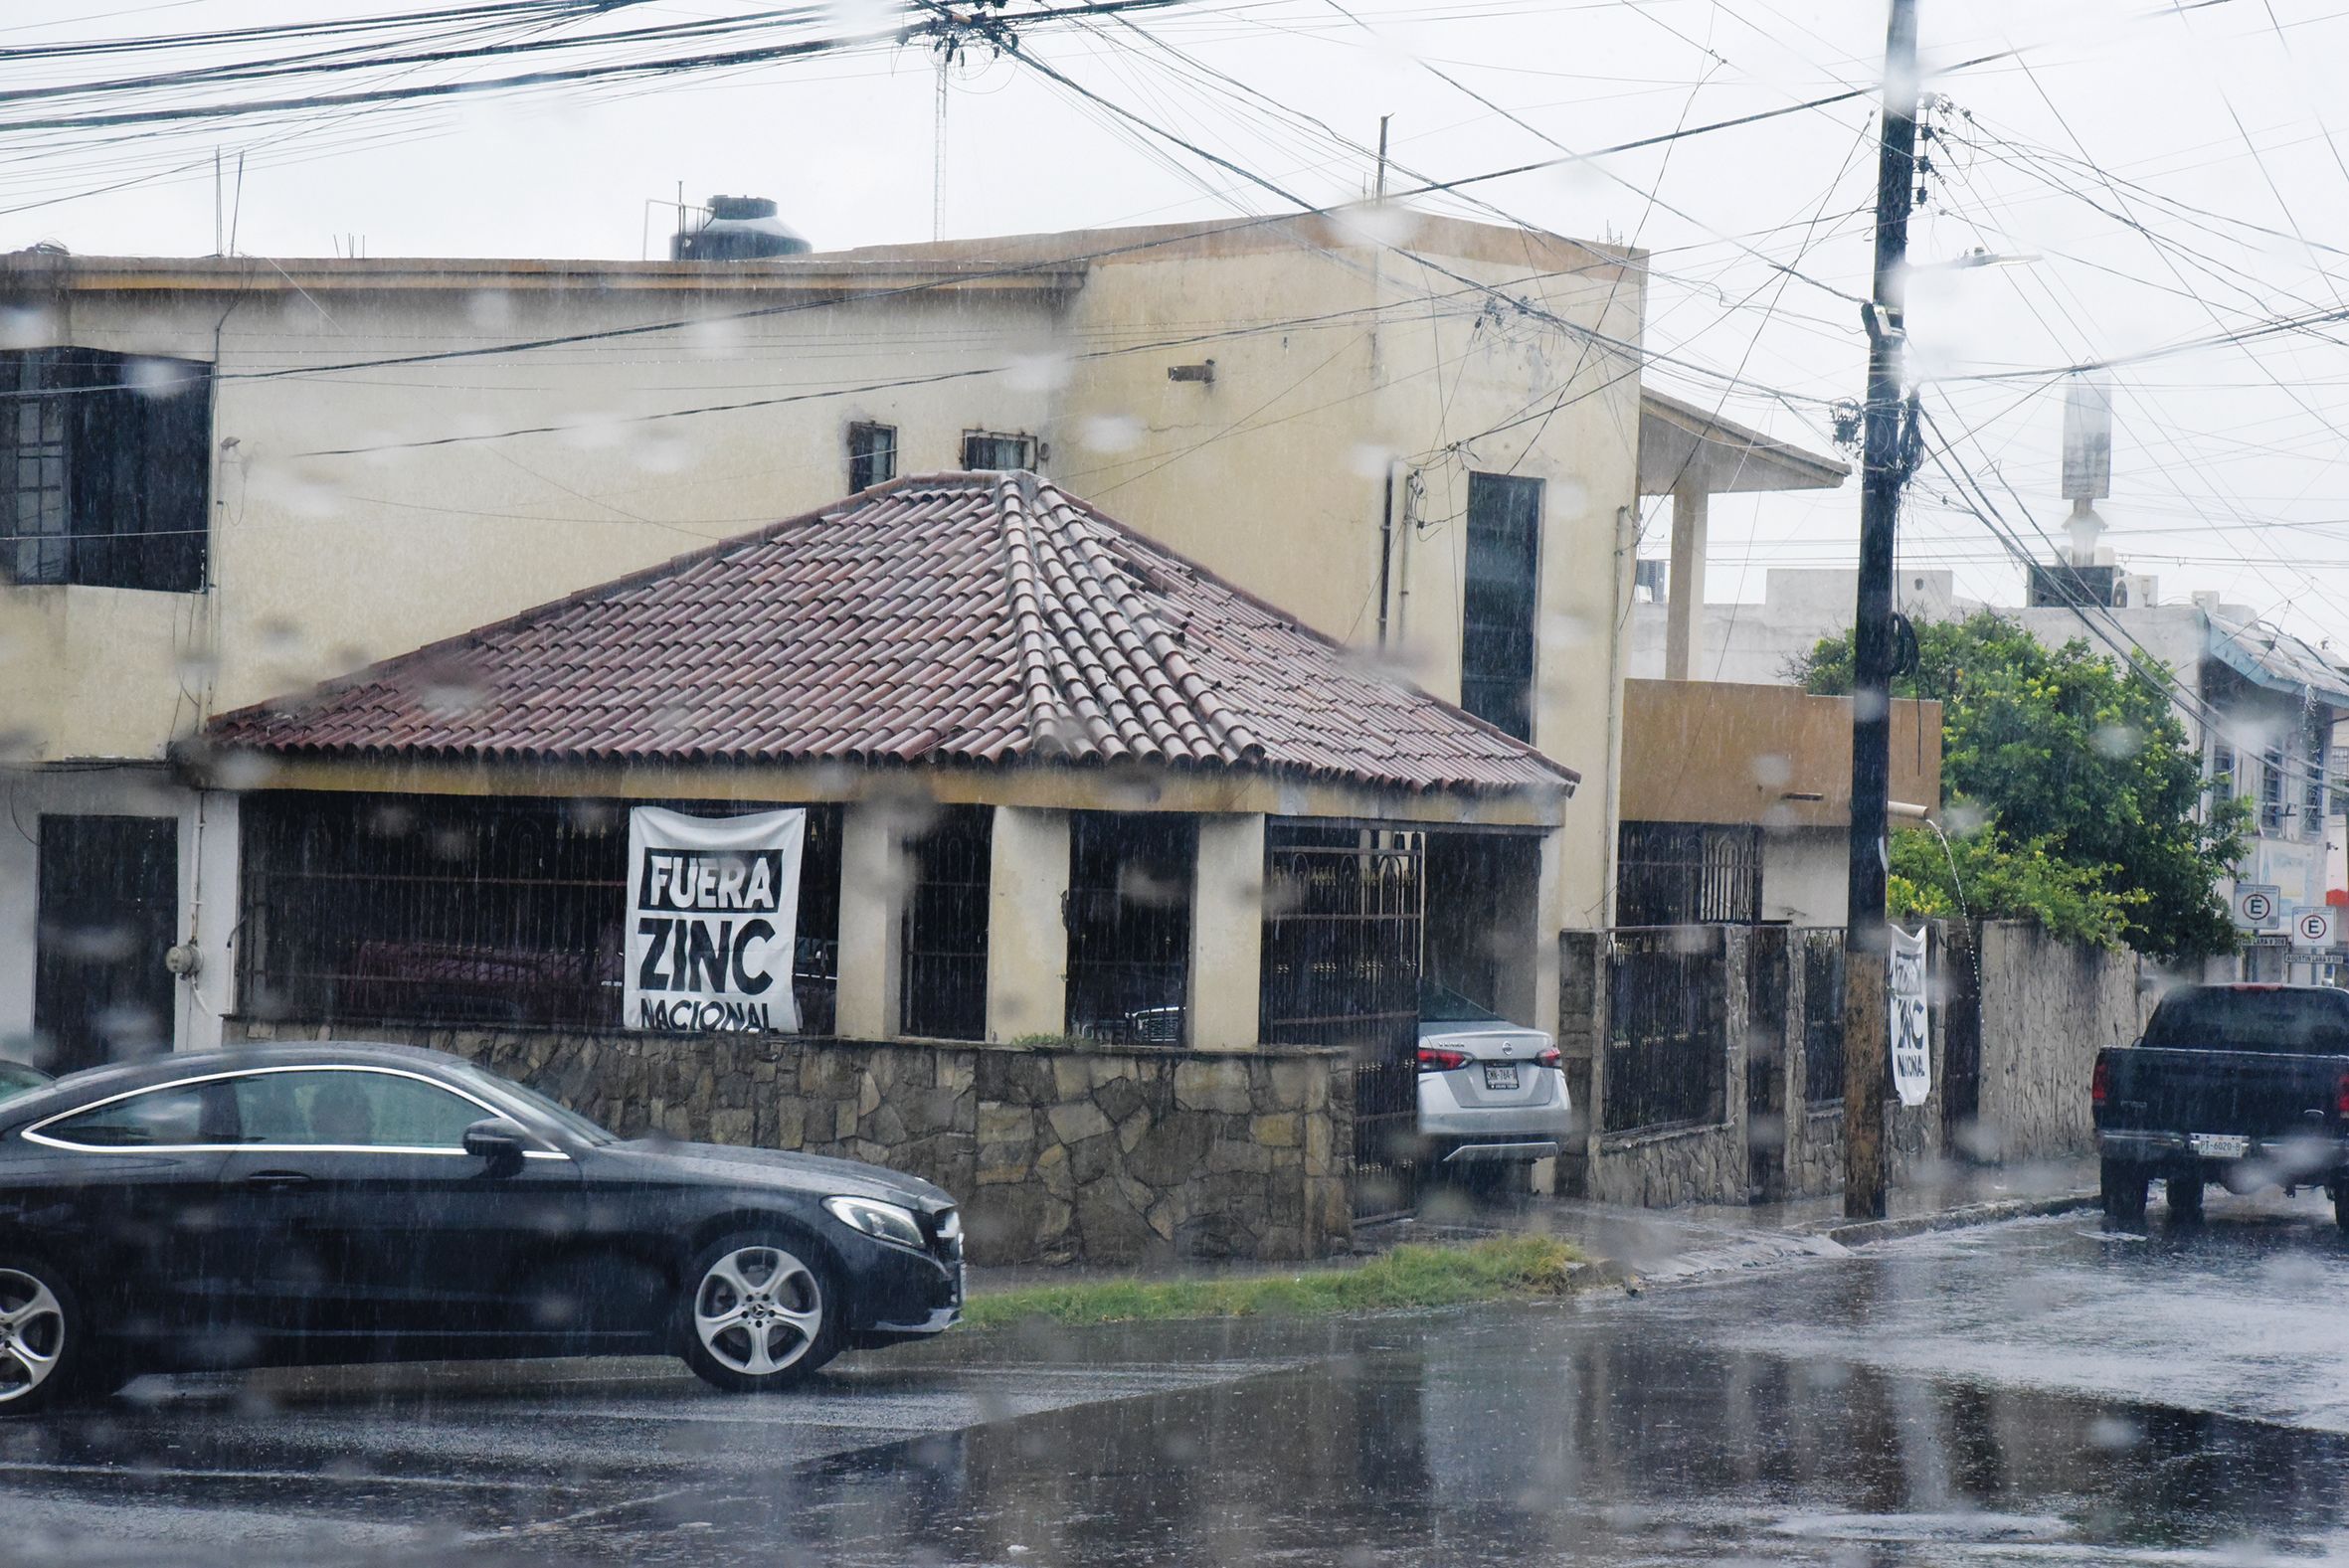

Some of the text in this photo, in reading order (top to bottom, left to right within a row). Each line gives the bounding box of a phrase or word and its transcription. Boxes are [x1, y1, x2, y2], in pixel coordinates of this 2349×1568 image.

[649, 855, 775, 909] FUERA
[2251, 899, 2262, 915] E
[2308, 920, 2319, 935] E
[637, 917, 776, 995] ZINC
[640, 998, 778, 1033] NACIONAL
